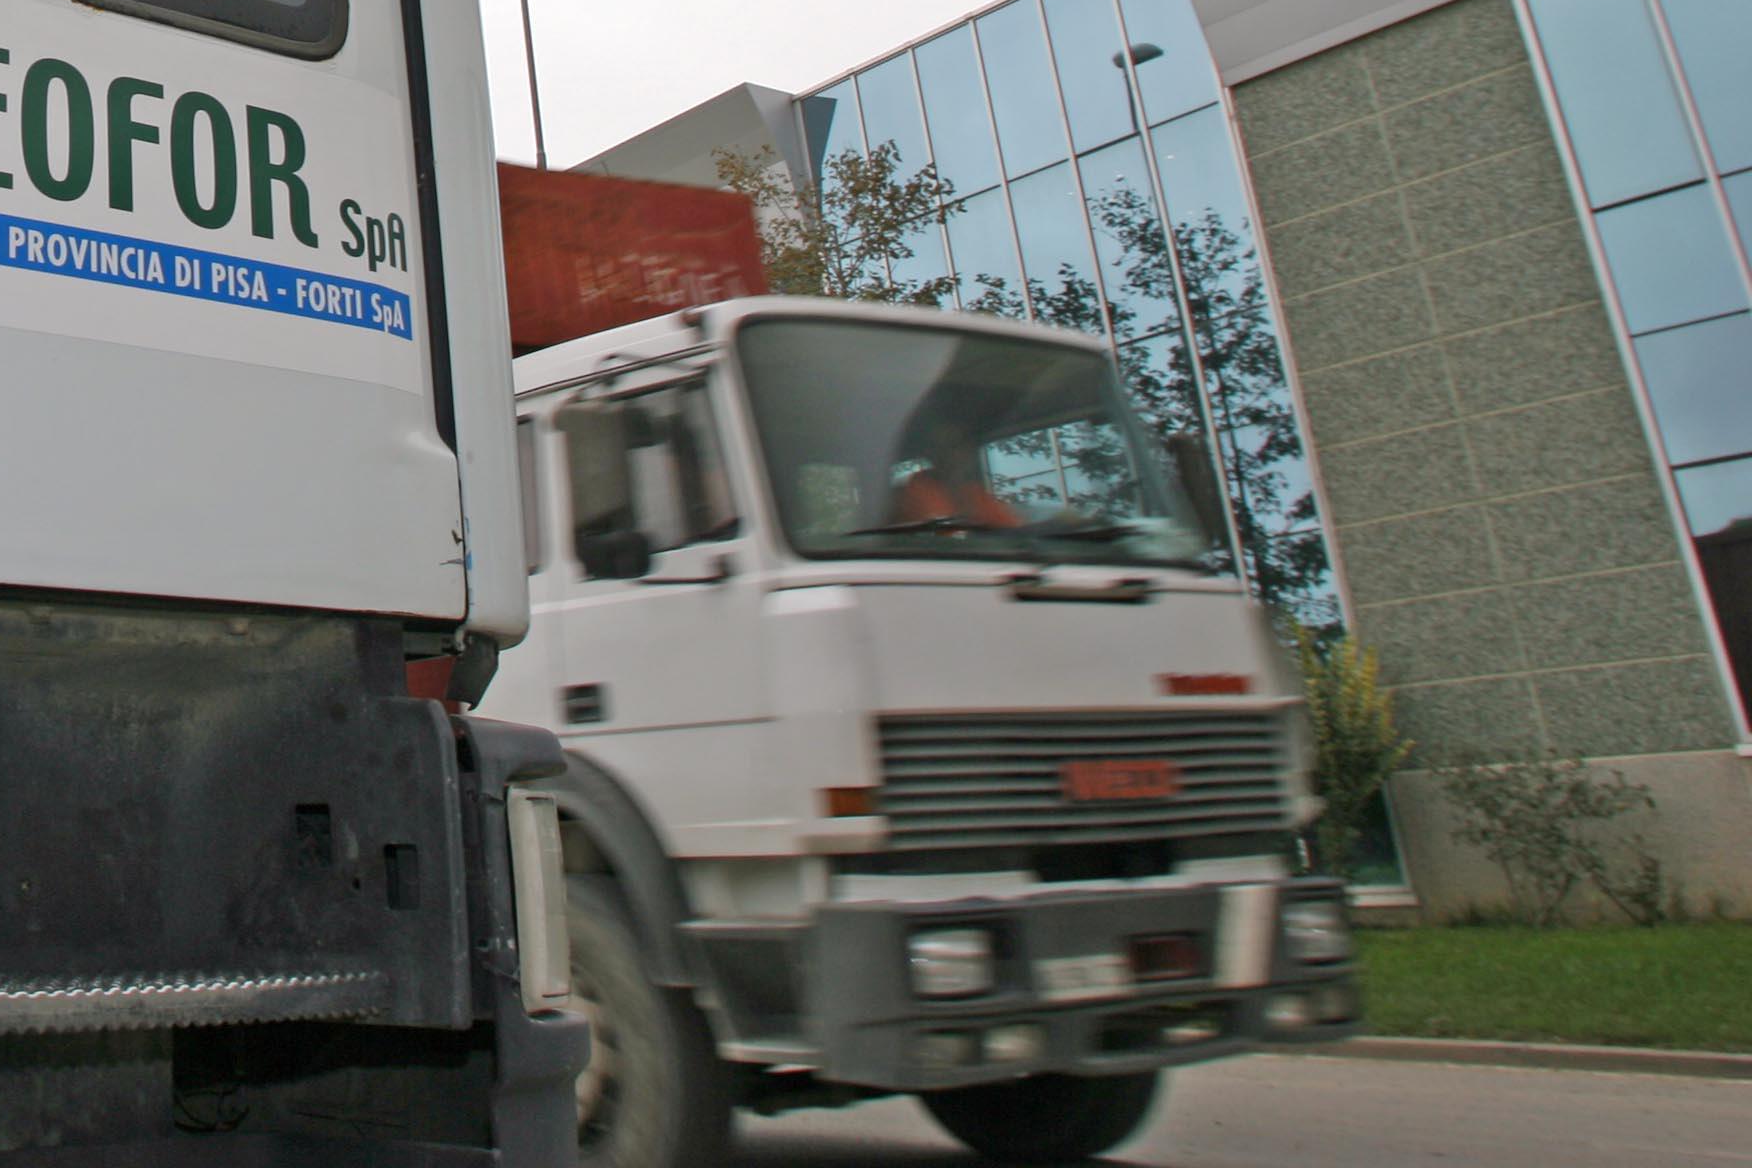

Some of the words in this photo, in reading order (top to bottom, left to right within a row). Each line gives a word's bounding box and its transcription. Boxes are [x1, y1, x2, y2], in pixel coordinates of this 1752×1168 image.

[8, 226, 165, 283] PROVINCIA
[175, 256, 200, 290] DI
[211, 262, 269, 302] PISA
[296, 278, 363, 320] FORTI
[370, 292, 405, 332] SpA
[340, 198, 407, 272] SpA
